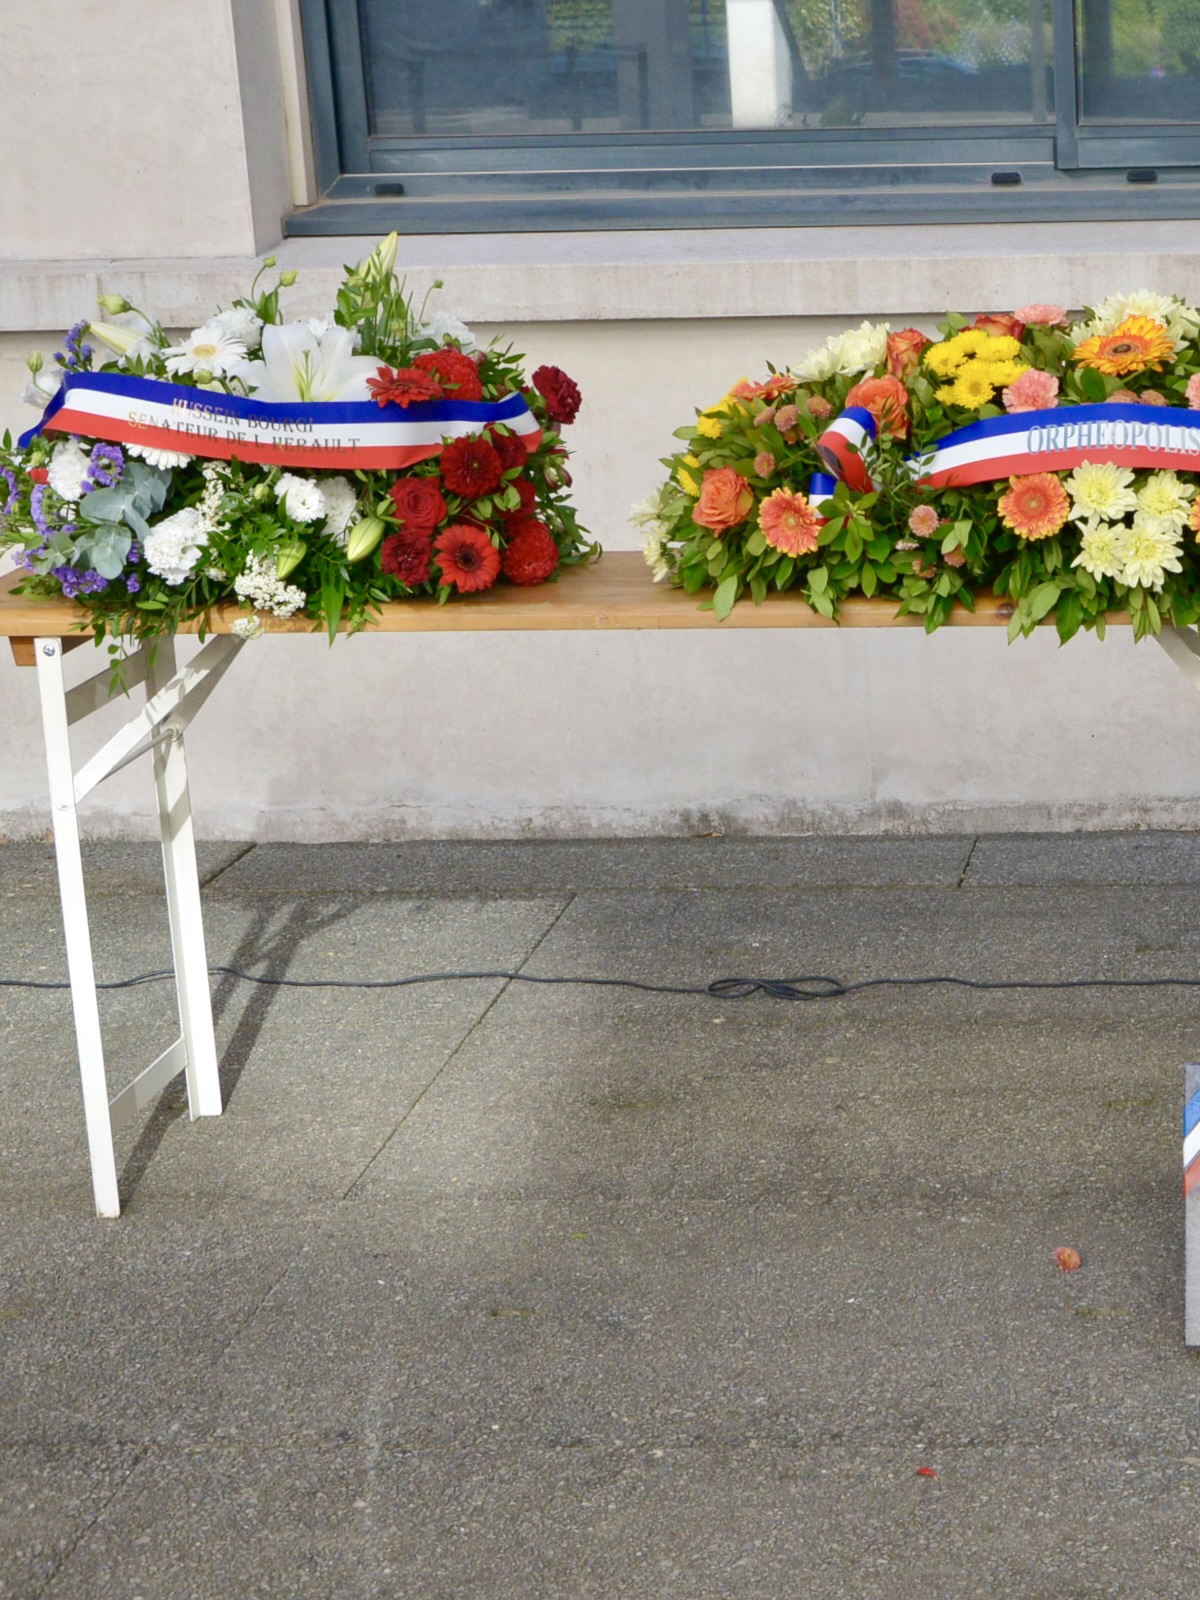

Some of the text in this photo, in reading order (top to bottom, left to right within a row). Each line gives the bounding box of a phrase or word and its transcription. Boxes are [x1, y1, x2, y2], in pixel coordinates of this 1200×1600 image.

[127, 411, 218, 442] SENATEUR
[225, 430, 247, 446] DE
[171, 398, 314, 433] HUSSEIN BOURGI
[1026, 419, 1200, 456] ORPHEOPOLIS
